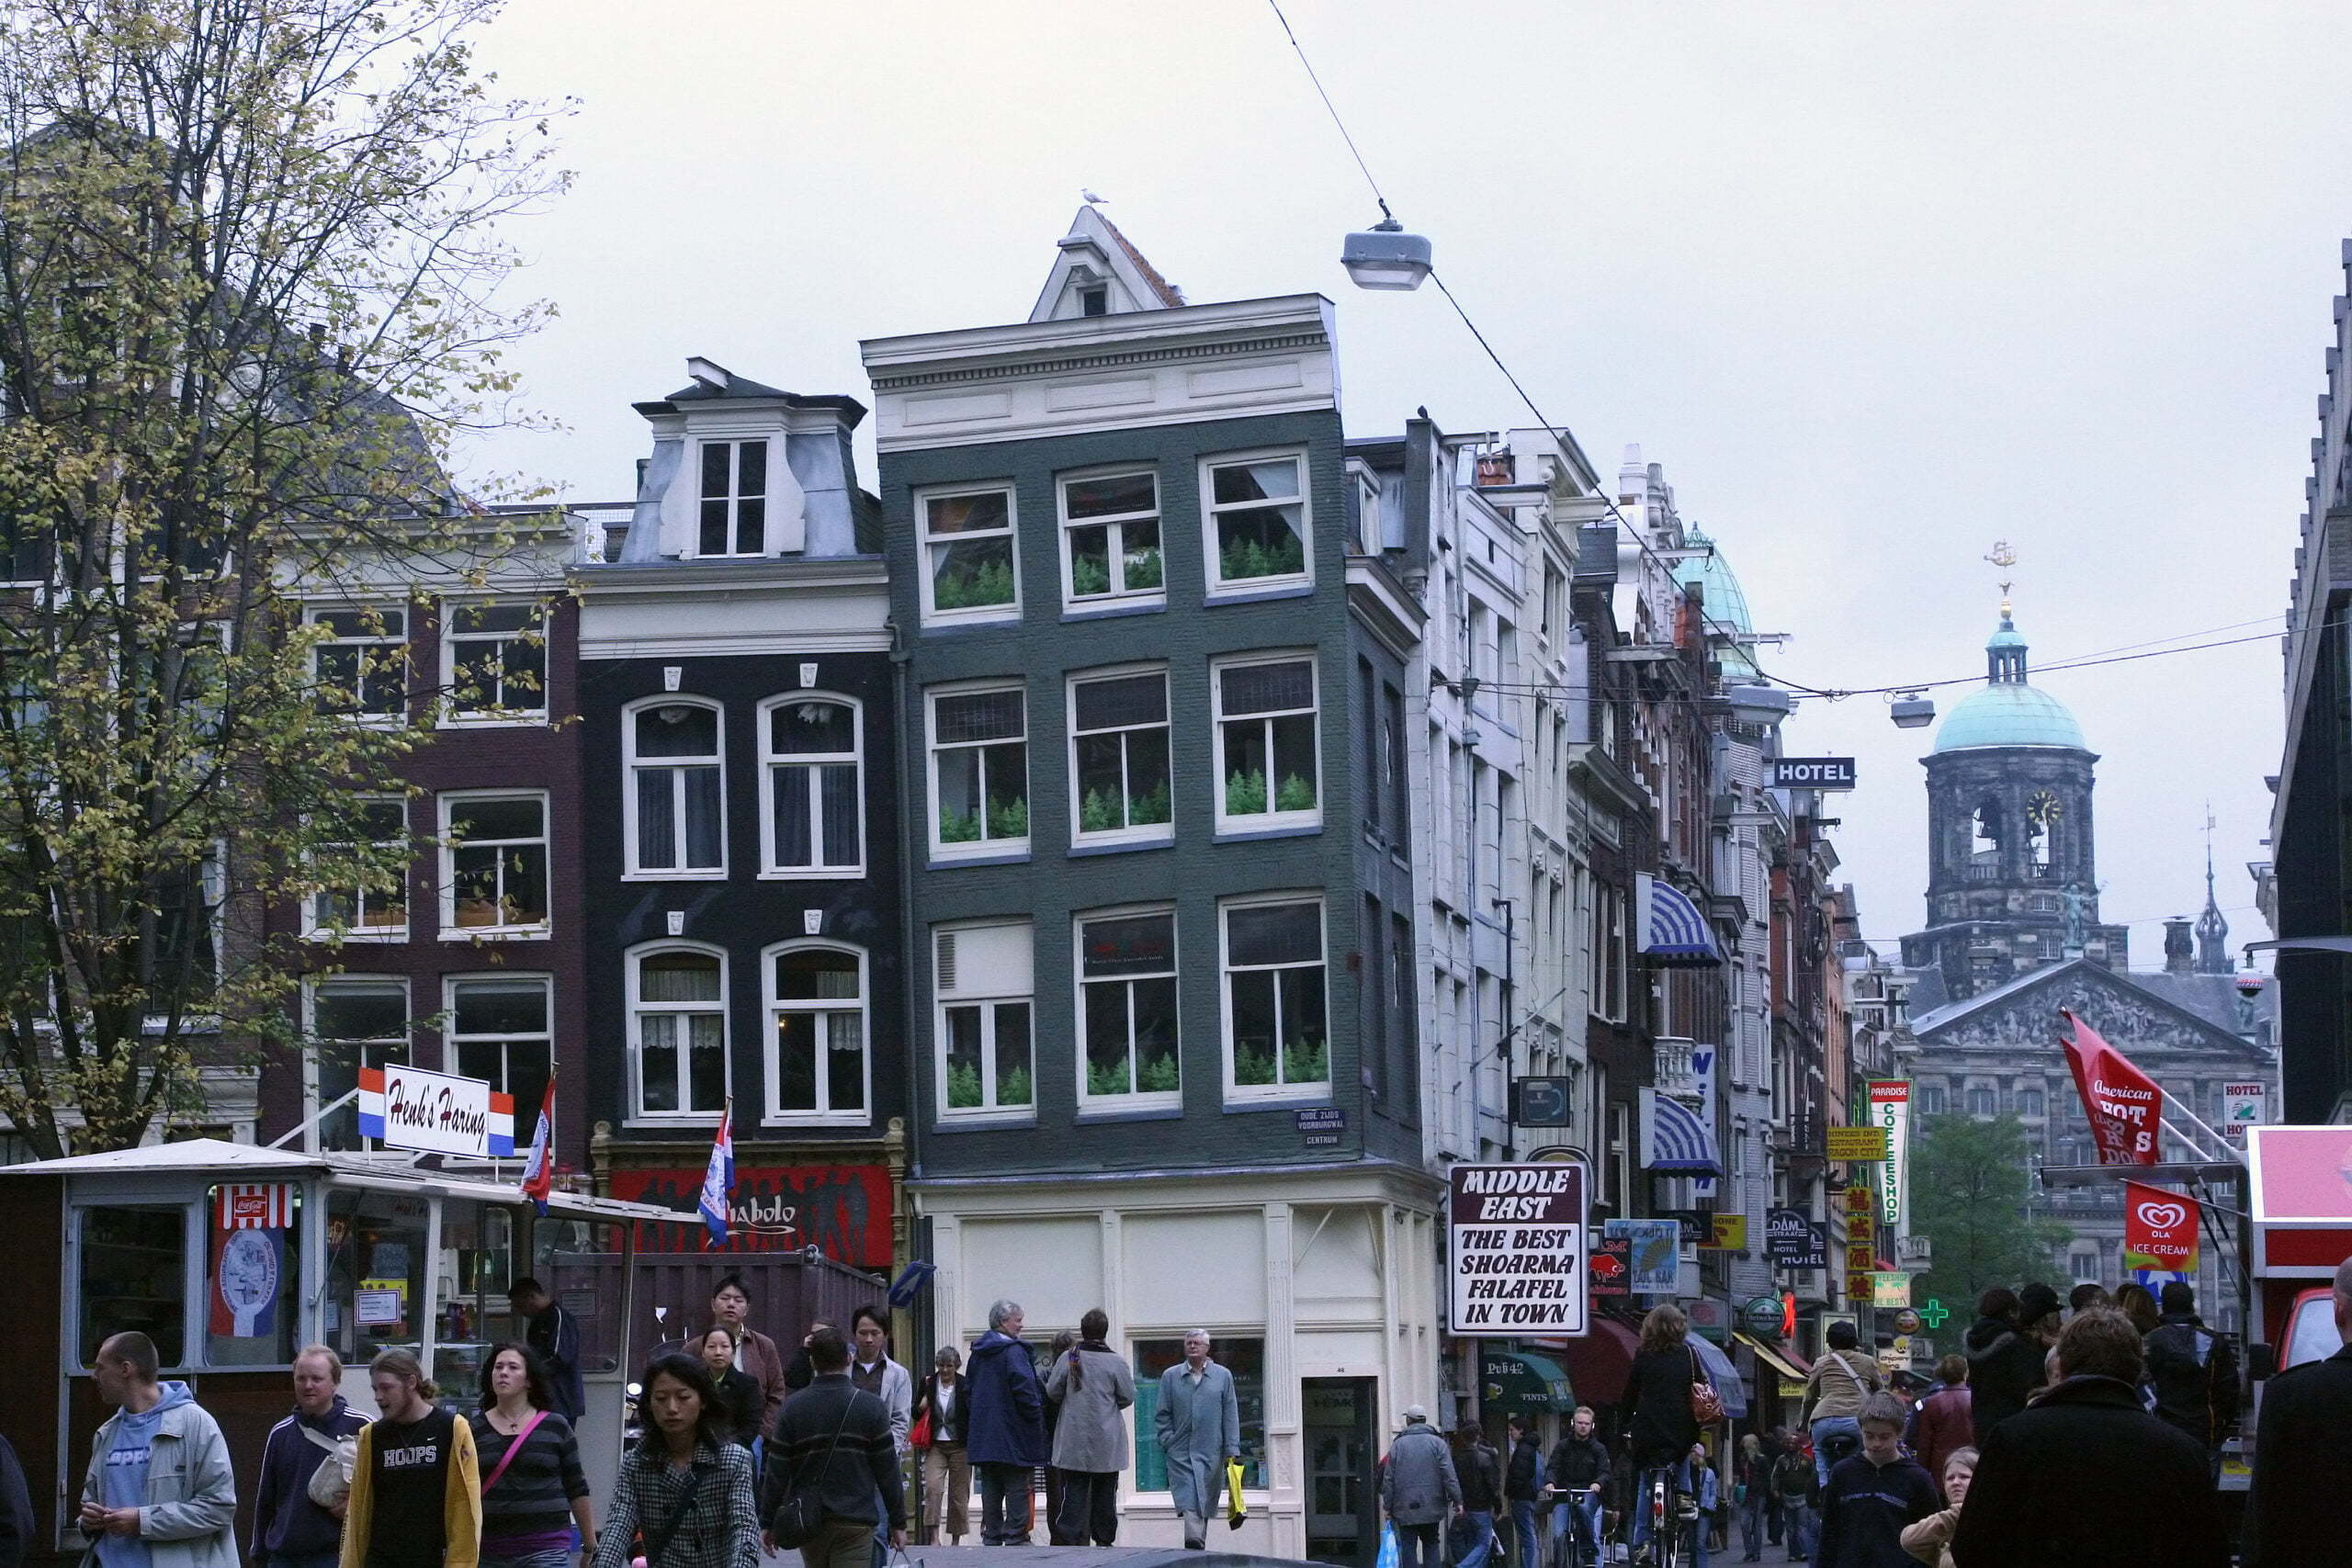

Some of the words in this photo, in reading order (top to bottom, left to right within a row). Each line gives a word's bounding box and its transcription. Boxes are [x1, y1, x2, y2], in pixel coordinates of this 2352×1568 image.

[1779, 764, 1850, 780] HOTEL
[1871, 1087, 1907, 1096] PARADISE
[2094, 1079, 2154, 1100] American
[2226, 1085, 2263, 1096] HOTEL
[390, 1077, 435, 1131] Henk's
[438, 1087, 486, 1152] Haring
[1300, 1111, 1317, 1120] OUDE
[1306, 1135, 1338, 1145] CENTRUM
[1829, 1138, 1879, 1146] ESTAURANT
[1828, 1147, 1859, 1156] RAGON
[1883, 1103, 1897, 1222] COFFEESHOP
[1462, 1169, 1570, 1194] MIDDLE
[726, 1195, 797, 1224] iabolo
[1479, 1197, 1553, 1220] EAST
[1772, 1216, 1798, 1231] DAM
[1462, 1230, 1507, 1249] THE
[1512, 1229, 1571, 1249] BEST
[2151, 1230, 2170, 1238] OLA
[2133, 1244, 2150, 1253] ICE
[2153, 1245, 2188, 1255] CREAM
[1460, 1255, 1575, 1274] SHOARMA
[1467, 1279, 1567, 1299] FALAFEL
[1464, 1303, 1494, 1324] IN
[1500, 1303, 1569, 1324] TOWN
[1487, 1362, 1508, 1375] Pub
[1510, 1362, 1524, 1375] 42
[383, 1445, 437, 1467] HOOPS
